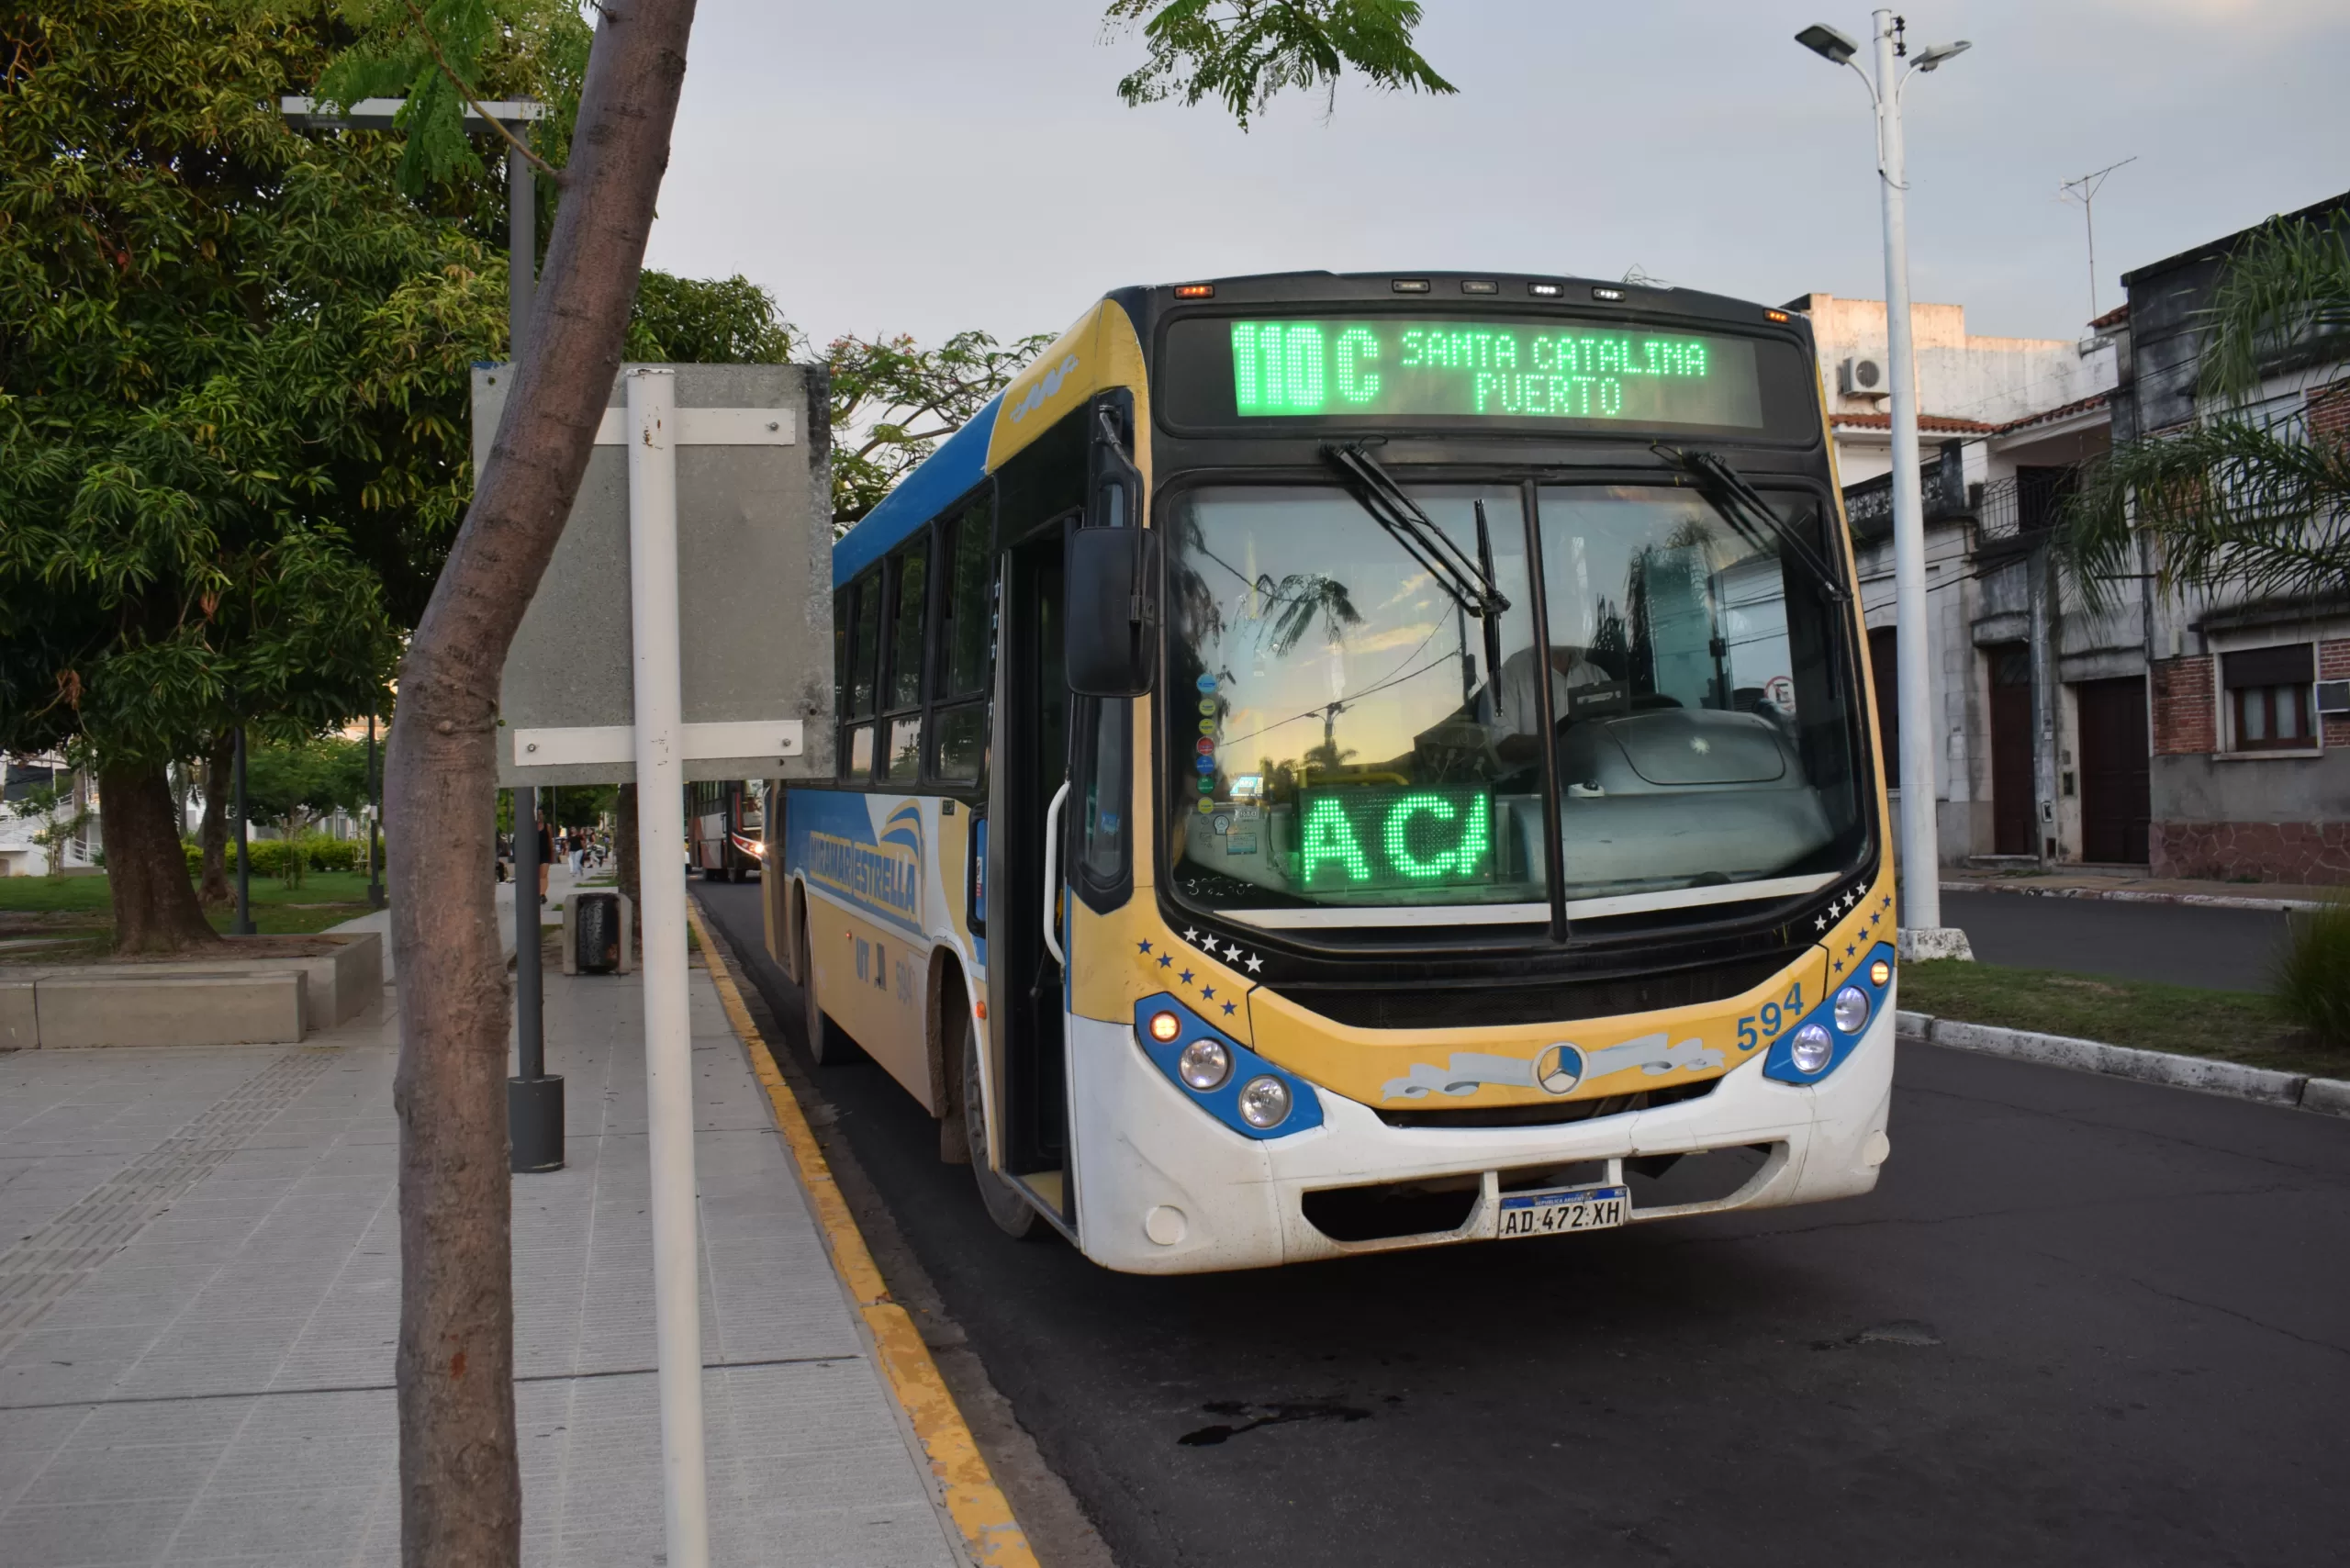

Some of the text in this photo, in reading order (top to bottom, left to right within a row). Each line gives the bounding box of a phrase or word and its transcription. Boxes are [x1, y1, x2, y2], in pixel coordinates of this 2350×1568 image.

[1233, 324, 1378, 406] 110 C
[1400, 330, 1707, 376] SANTA CATALINA
[1475, 372, 1621, 415] PUERTO
[853, 843, 917, 921] ESTRELLA
[1737, 981, 1805, 1051] 594
[1505, 1200, 1620, 1235] AD 472 XH
